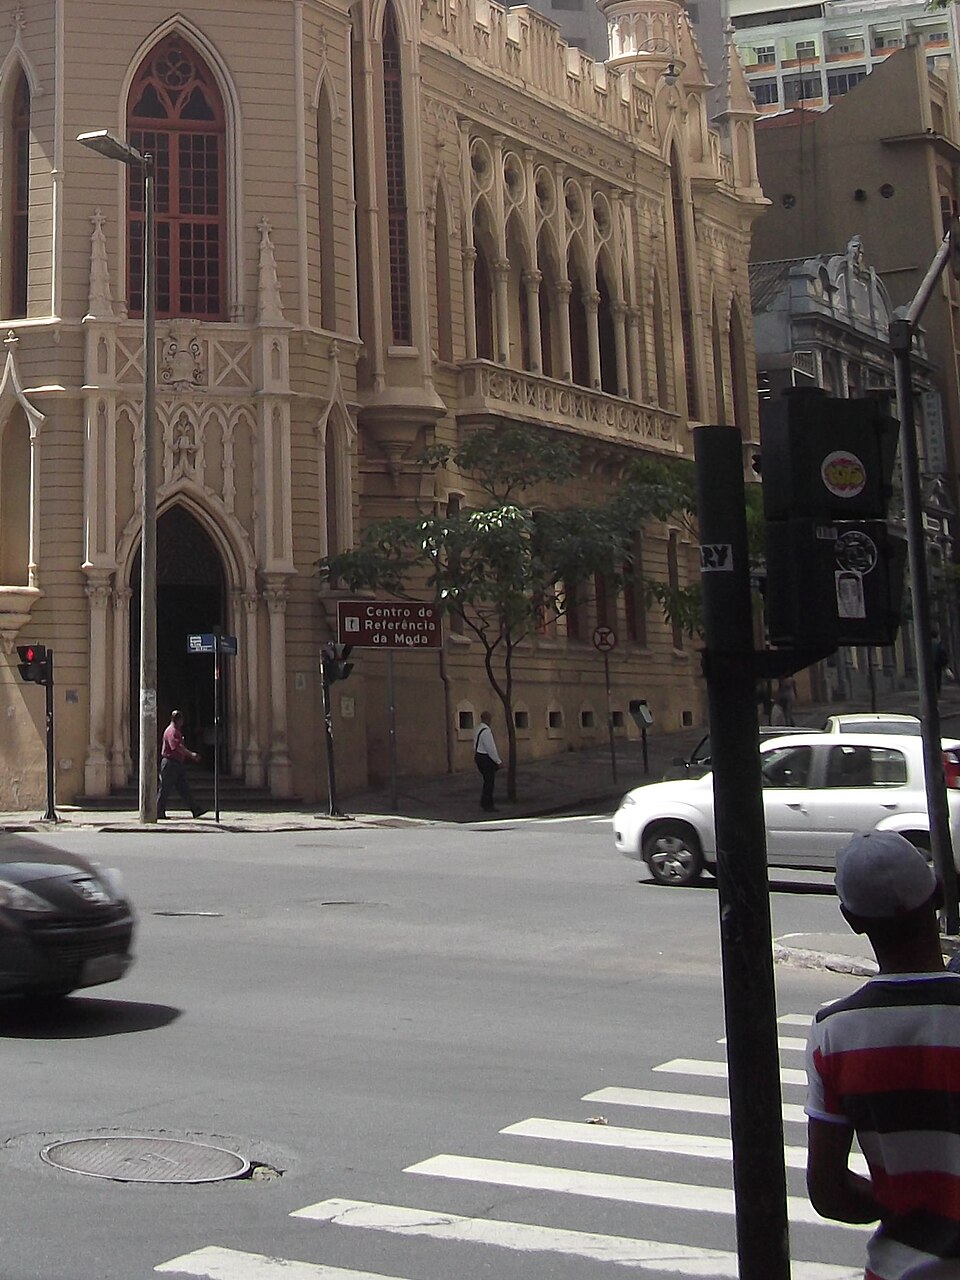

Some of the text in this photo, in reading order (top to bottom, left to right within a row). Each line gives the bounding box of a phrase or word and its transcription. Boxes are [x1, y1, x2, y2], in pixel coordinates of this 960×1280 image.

[366, 606, 433, 617] Centro de
[364, 619, 436, 631] Referência
[373, 633, 428, 645] da Moda
